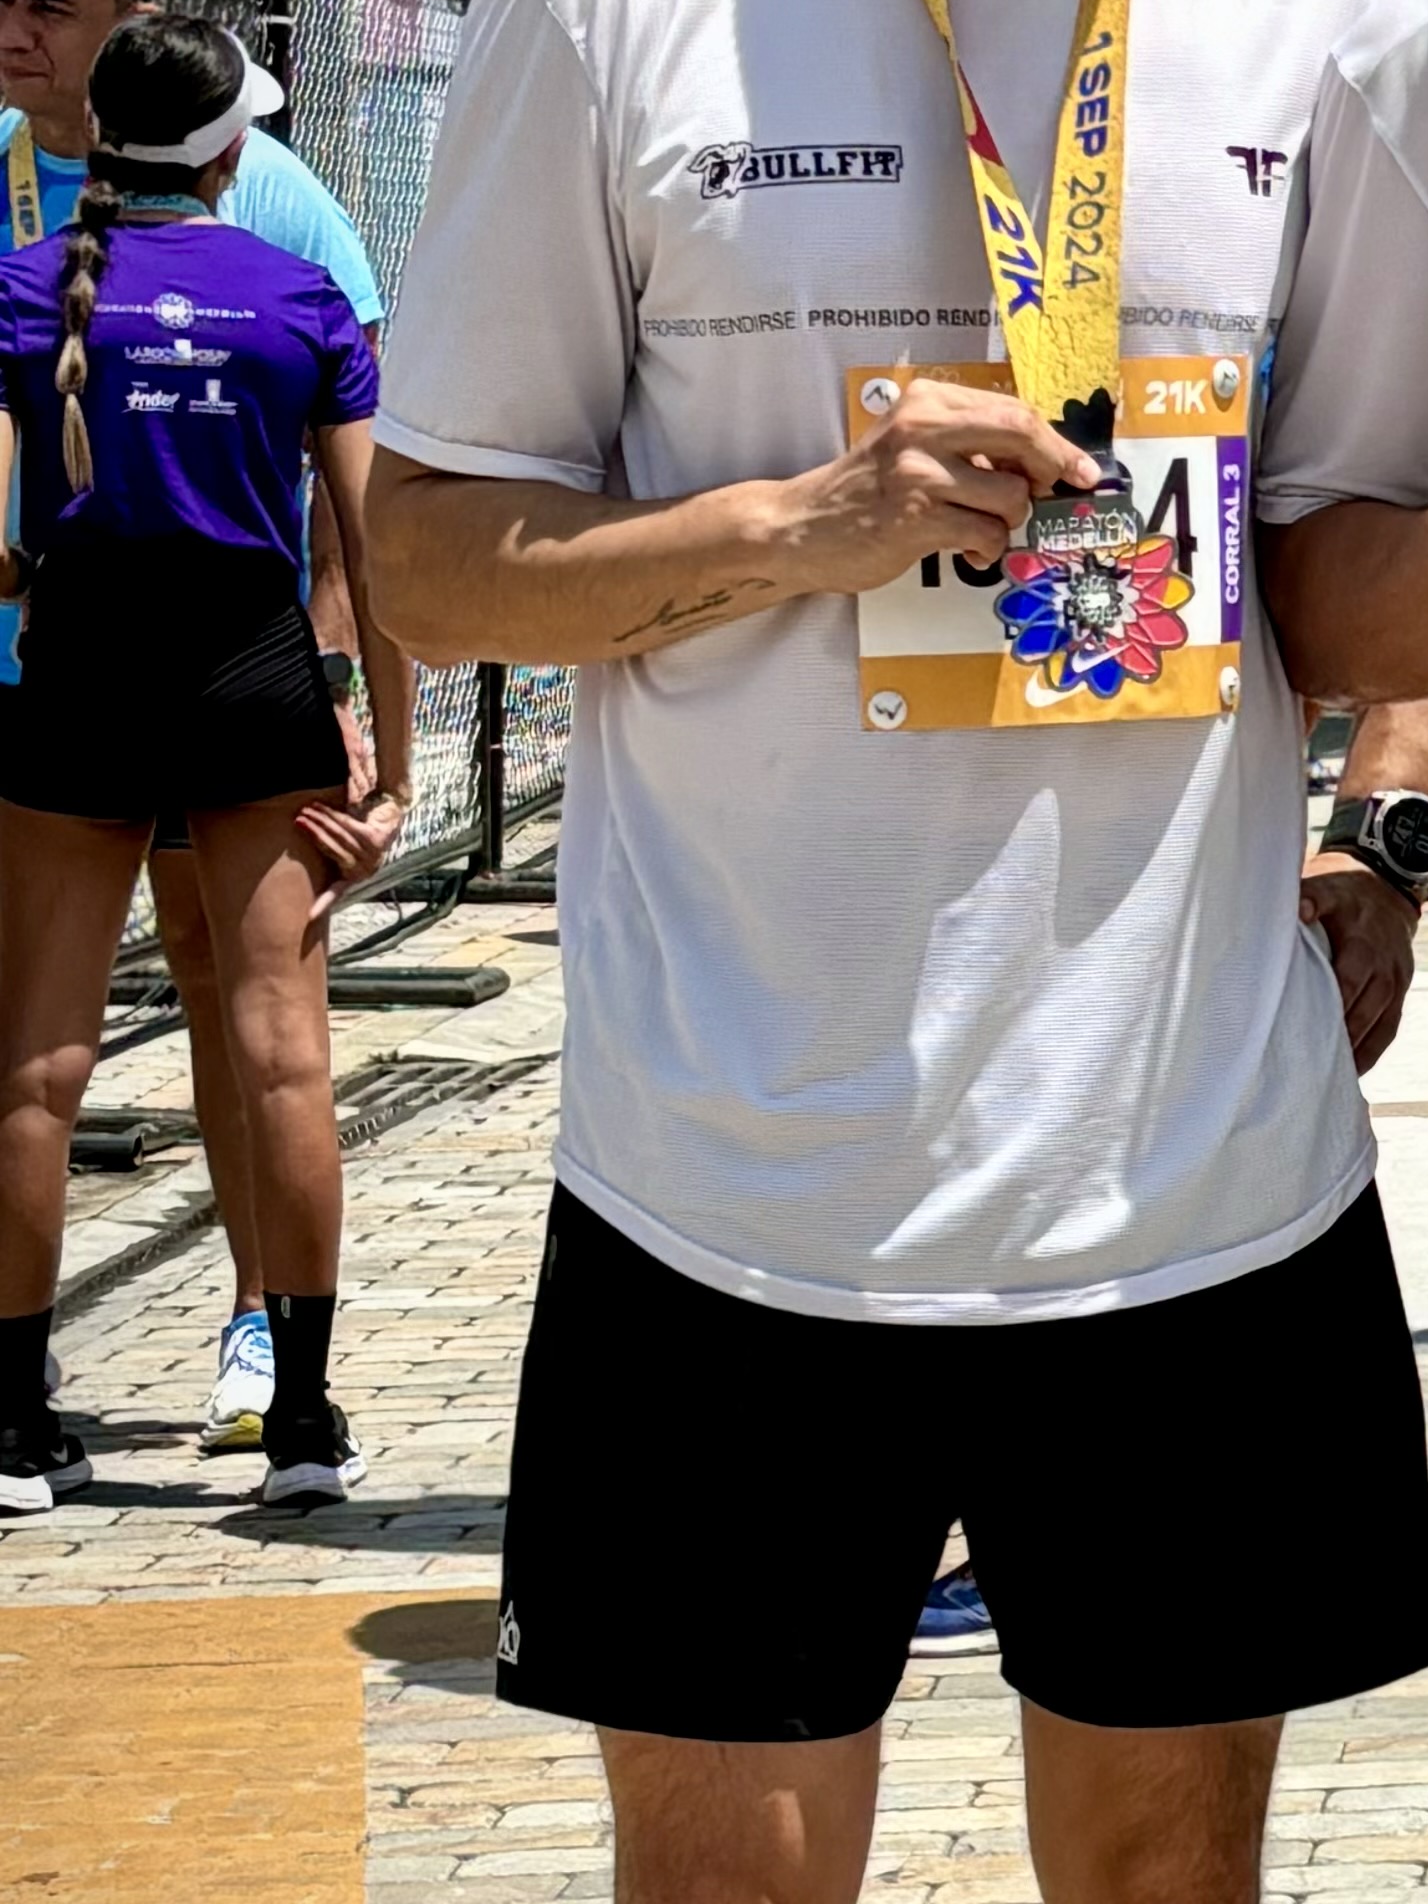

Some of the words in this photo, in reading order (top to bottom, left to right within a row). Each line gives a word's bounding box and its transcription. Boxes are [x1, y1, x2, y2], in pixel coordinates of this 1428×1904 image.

[1081, 31, 1114, 56] 1
[1075, 60, 1112, 158] SEP
[984, 194, 1045, 318] 21K
[1062, 171, 1107, 289] 2024
[807, 307, 931, 329] PROHIBIDO
[1143, 380, 1208, 416] 21K
[1223, 463, 1240, 481] 3
[1223, 487, 1241, 604] CORRAL
